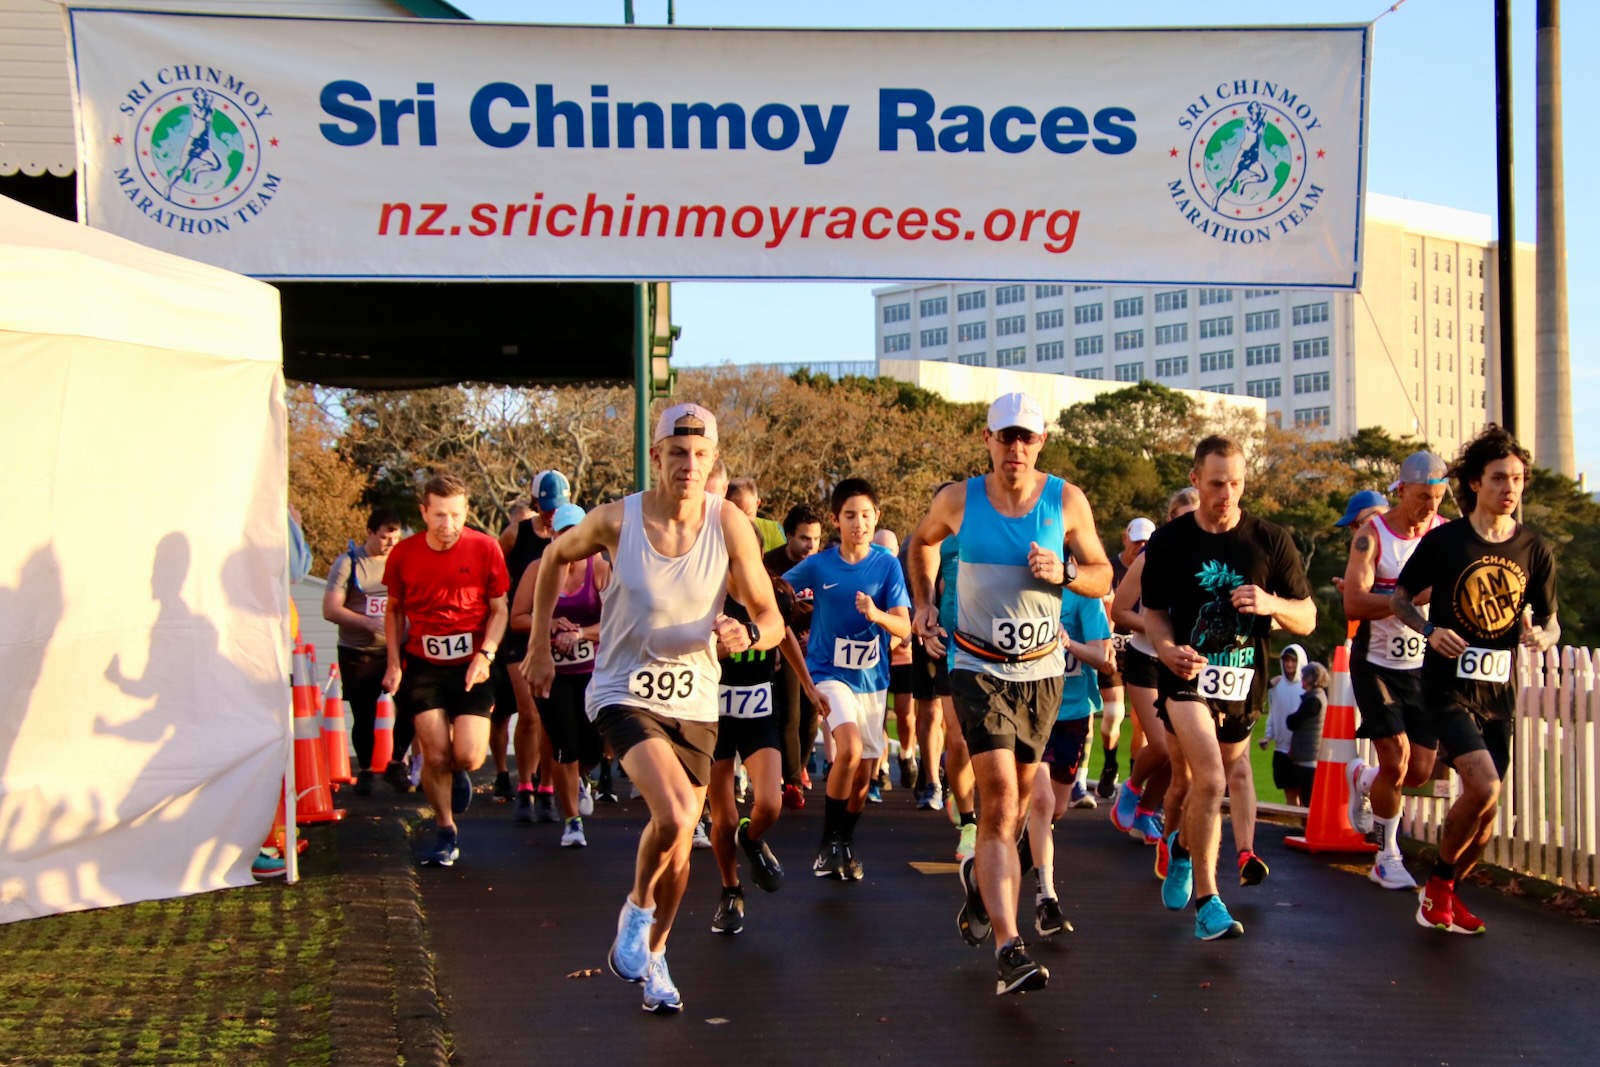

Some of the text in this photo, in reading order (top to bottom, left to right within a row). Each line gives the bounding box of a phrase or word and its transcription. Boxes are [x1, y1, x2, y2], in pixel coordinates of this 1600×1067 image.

[119, 65, 273, 119] SRI CHINMOY
[1178, 79, 1322, 132] SRI CHINMOY
[319, 79, 1137, 165] Sri Chinmoy Races
[114, 167, 282, 235] MARATHON TEAM
[1167, 178, 1325, 244] MARATHON TEAM
[377, 192, 1081, 254] nz.srichinmoyraces.org
[1476, 568, 1511, 597] AM
[1471, 590, 1518, 632] HOPE
[426, 635, 469, 656] 614
[998, 620, 1050, 651] 390
[1391, 636, 1427, 658] 39
[551, 640, 590, 663] 65
[841, 643, 878, 666] 174
[1460, 650, 1508, 677] 600
[634, 669, 694, 700] 393
[1203, 668, 1247, 697] 391
[720, 687, 769, 714] 172
